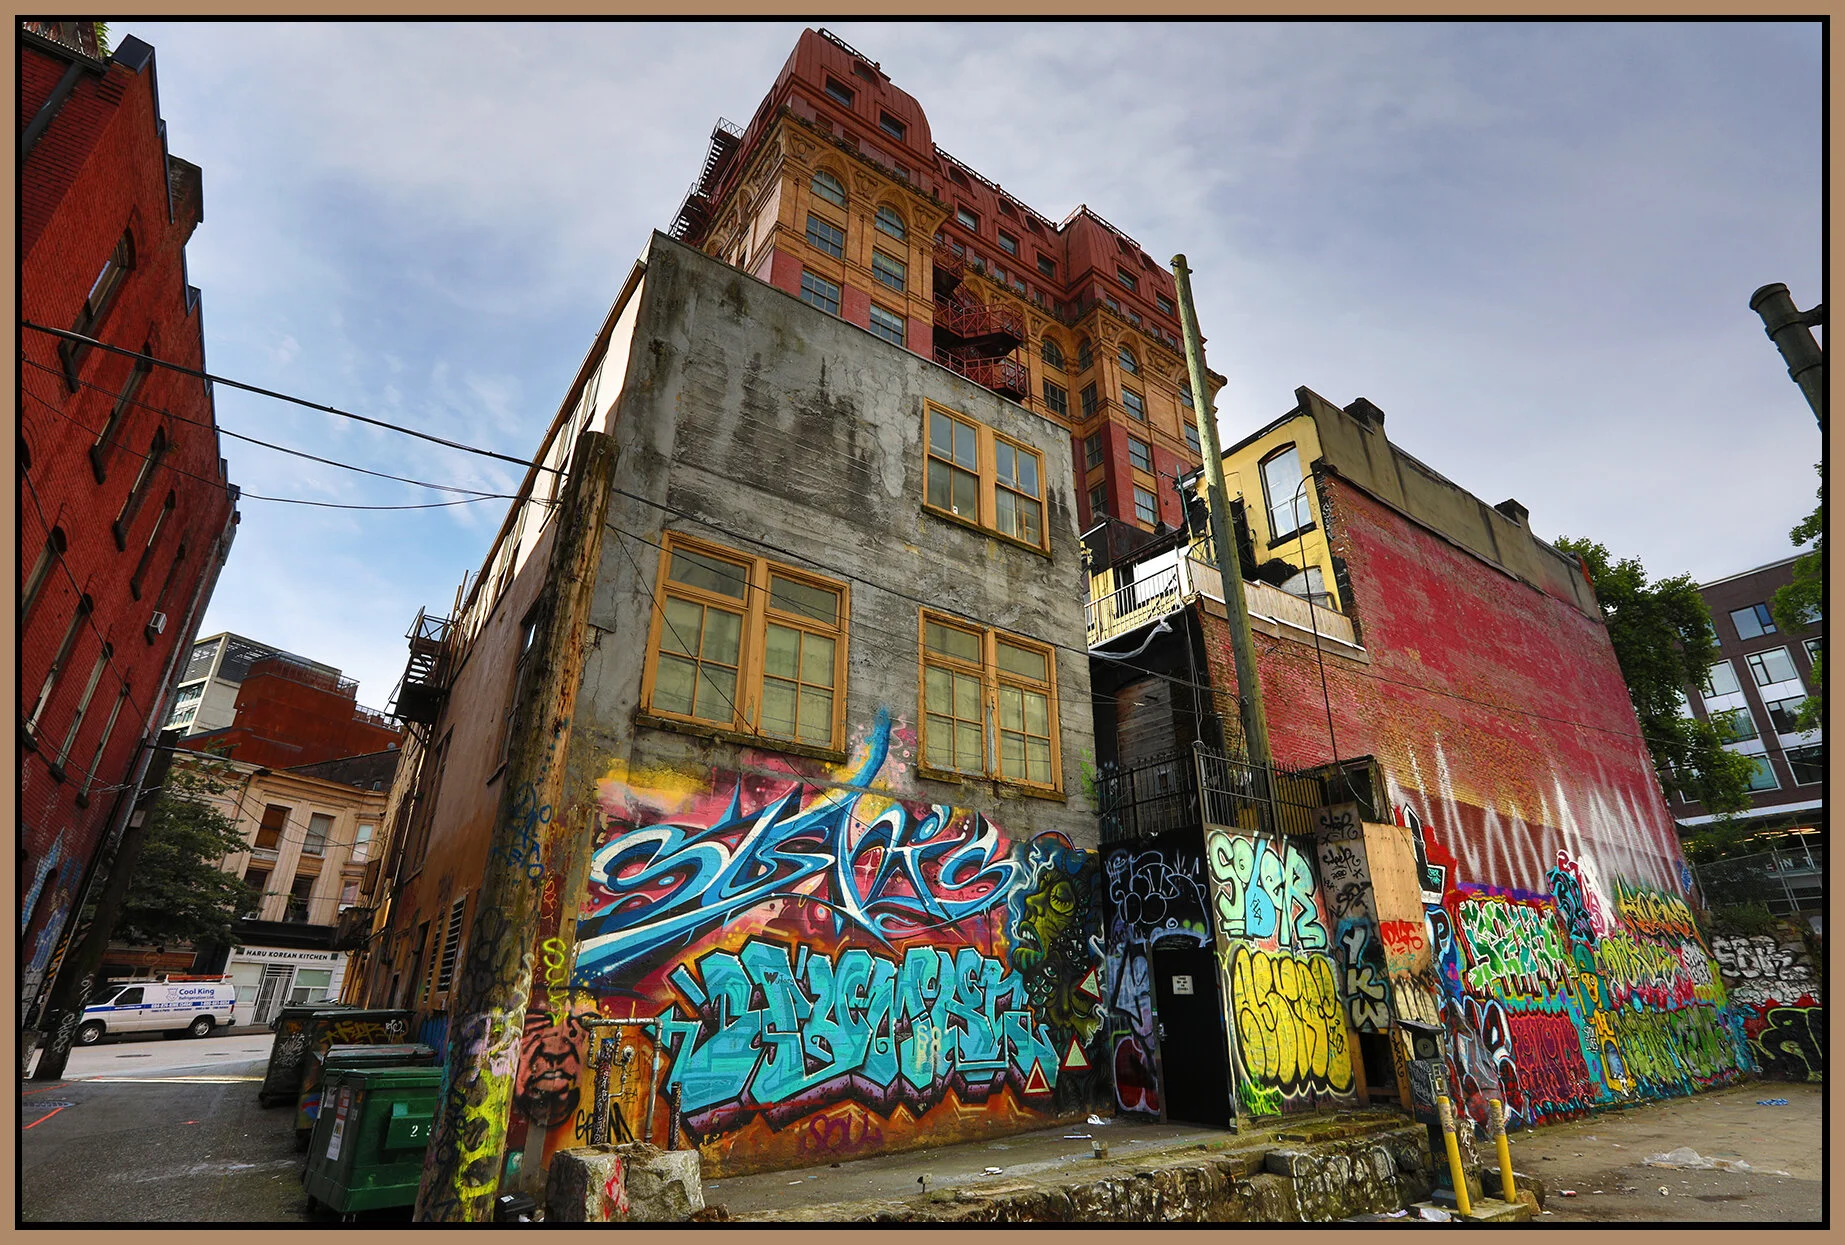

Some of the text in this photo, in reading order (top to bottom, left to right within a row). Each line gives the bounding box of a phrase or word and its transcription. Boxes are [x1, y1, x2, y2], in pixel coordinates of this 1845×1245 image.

[246, 949, 267, 957] HARU
[268, 951, 297, 959] KOREAN
[197, 987, 215, 996] King
